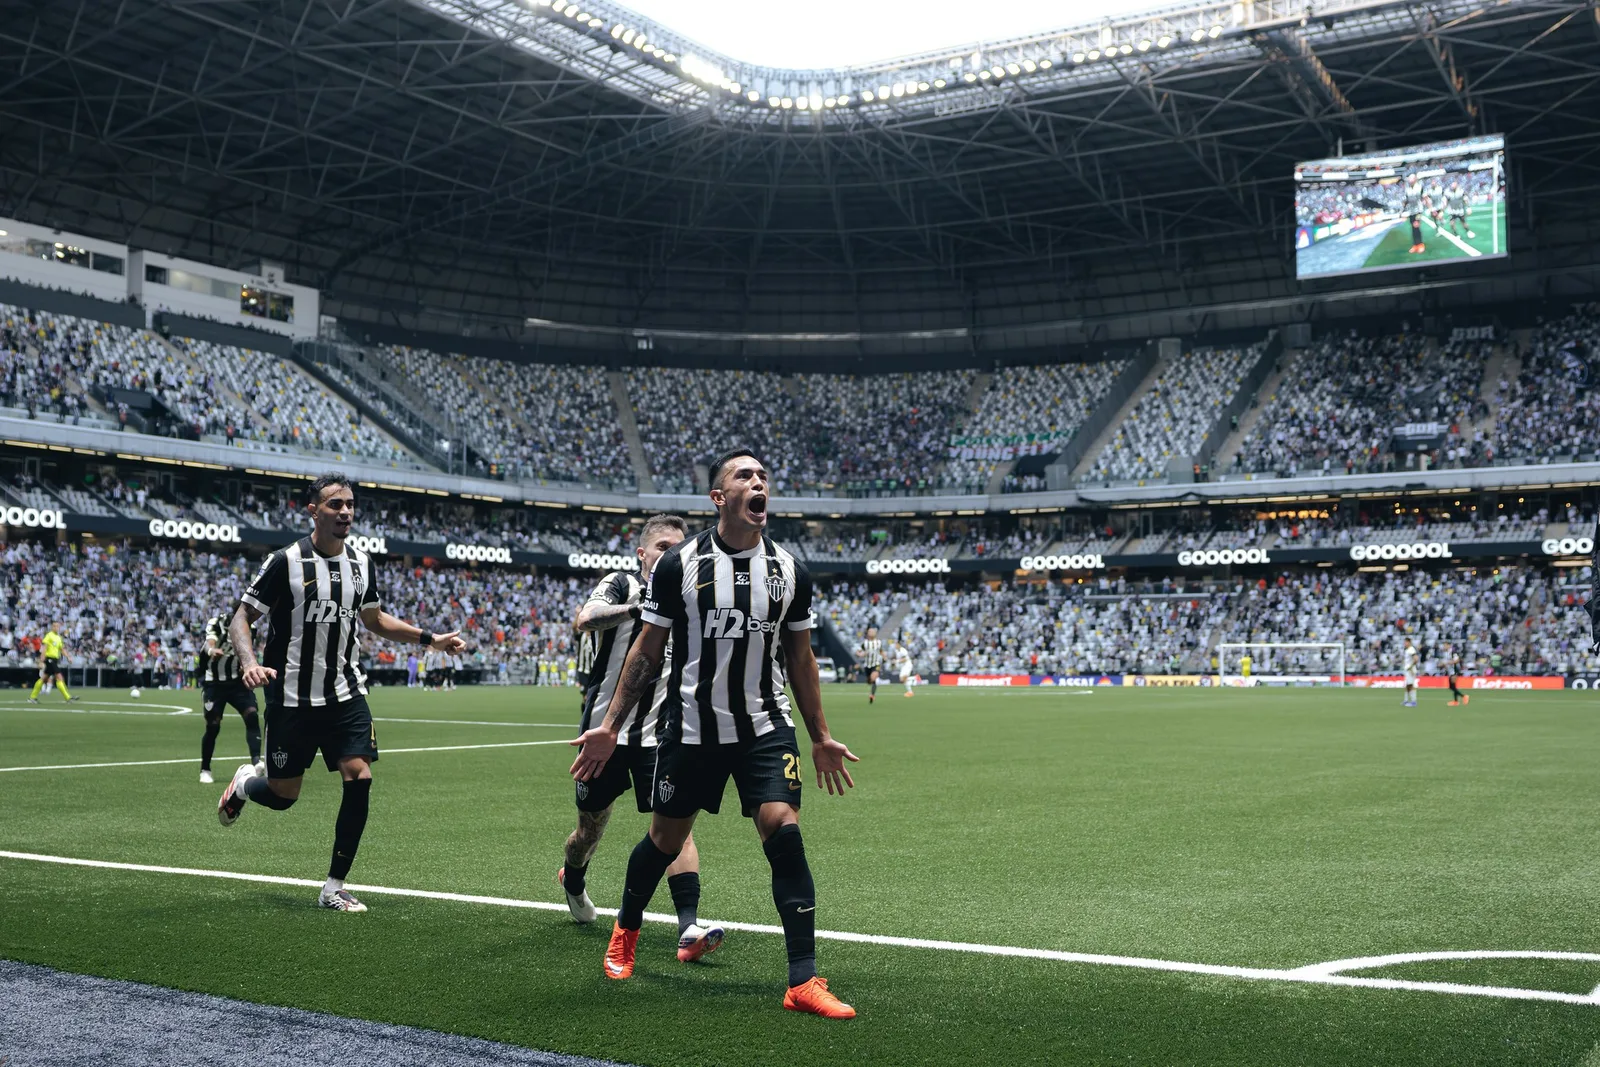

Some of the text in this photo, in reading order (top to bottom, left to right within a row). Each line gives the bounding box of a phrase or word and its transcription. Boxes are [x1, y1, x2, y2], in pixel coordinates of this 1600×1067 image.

[149, 518, 242, 543] GOOOOOL
[445, 544, 513, 564] GOOOOOL
[1177, 548, 1271, 566] GOOOOOL
[1350, 542, 1452, 561] GOOOOOL
[568, 552, 640, 571] GOOOOOL
[866, 558, 951, 574] GOOOOOL
[1020, 553, 1105, 570] GOOOOOL
[1472, 678, 1532, 689] Betano
